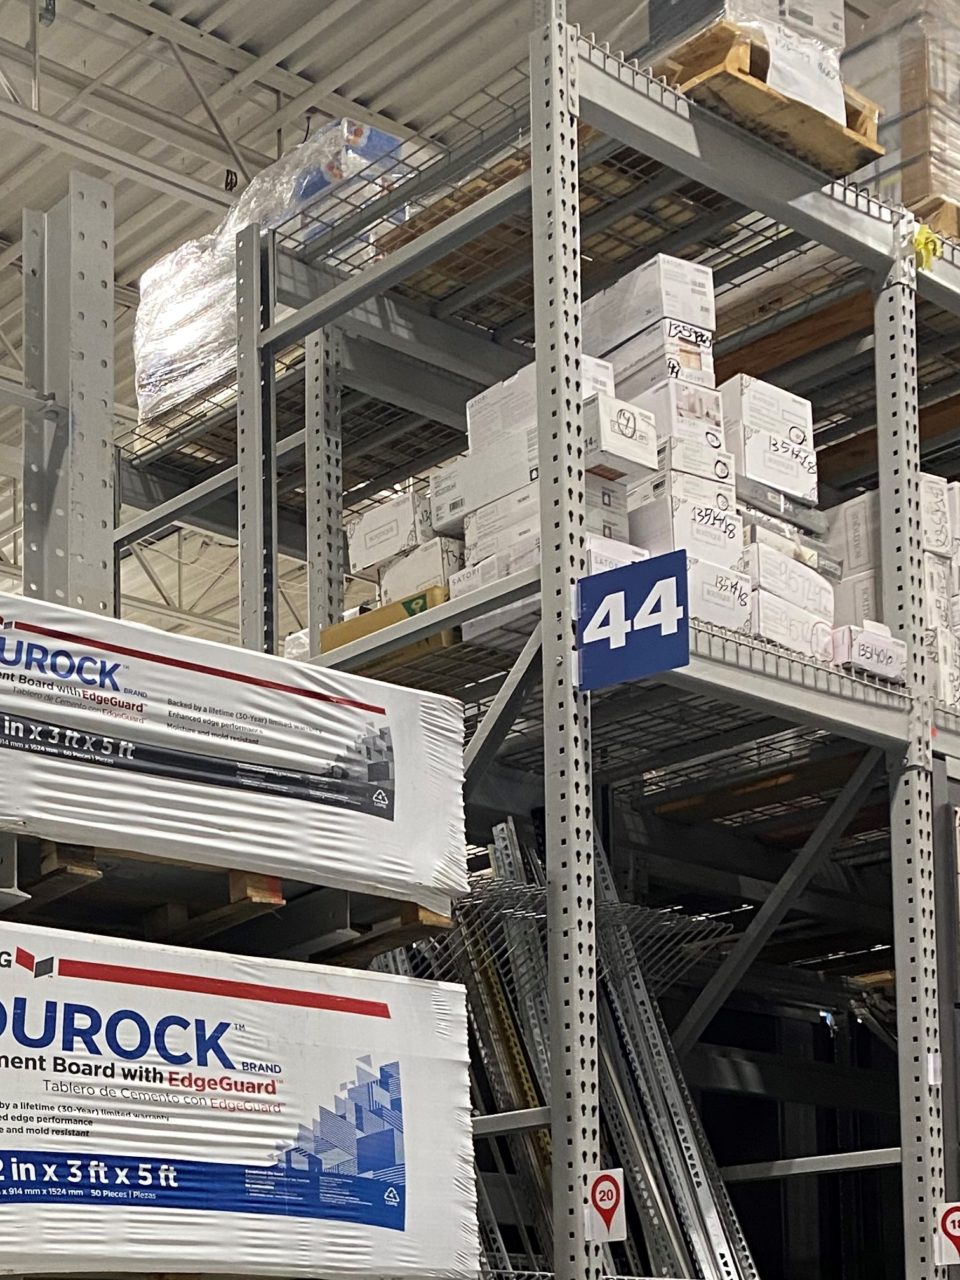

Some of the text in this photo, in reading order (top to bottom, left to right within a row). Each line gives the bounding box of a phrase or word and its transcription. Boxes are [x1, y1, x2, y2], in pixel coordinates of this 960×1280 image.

[452, 567, 480, 586] SATORI
[583, 577, 683, 649] 44
[18, 674, 54, 690] Board
[56, 683, 81, 697] with
[124, 687, 147, 698] BRAND
[13, 686, 42, 700] Tablero
[44, 692, 53, 702] de
[55, 697, 87, 711] Cemento
[167, 698, 192, 711] Backed
[193, 703, 201, 713] by
[208, 706, 234, 719] lifetime
[168, 710, 219, 730] Enhanced edge
[4, 715, 23, 737] in
[29, 728, 42, 740] x
[47, 725, 60, 744] 3
[83, 737, 95, 752] x
[101, 738, 114, 757] 5
[53, 1056, 115, 1079] Board
[121, 1065, 164, 1084] with
[242, 1061, 281, 1074] BRAND
[43, 1079, 95, 1096] Tablero
[99, 1084, 117, 1098] de
[120, 1088, 179, 1104] Cemento
[184, 1095, 207, 1106] con
[0, 1101, 11, 1112] by
[20, 1101, 55, 1112] lifetime
[57, 1104, 99, 1116] (30-Year)
[10, 1114, 35, 1125] edge
[36, 1115, 93, 1126] performance
[6, 1126, 24, 1135] and
[25, 1126, 50, 1136] mold
[51, 1128, 90, 1138] resistant
[11, 1157, 36, 1181] in
[43, 1163, 59, 1183] x
[67, 1159, 82, 1183] 3
[89, 1161, 109, 1184] ft
[115, 1167, 131, 1185] x
[138, 1163, 152, 1187] 5
[158, 1164, 179, 1188] ft
[8, 1187, 23, 1196] 914
[24, 1188, 40, 1196] mm
[48, 1187, 67, 1196] 1524
[90, 1189, 102, 1198] 50
[103, 1189, 127, 1199] Pieces
[133, 1190, 156, 1200] Piezas
[599, 1189, 613, 1202] 20
